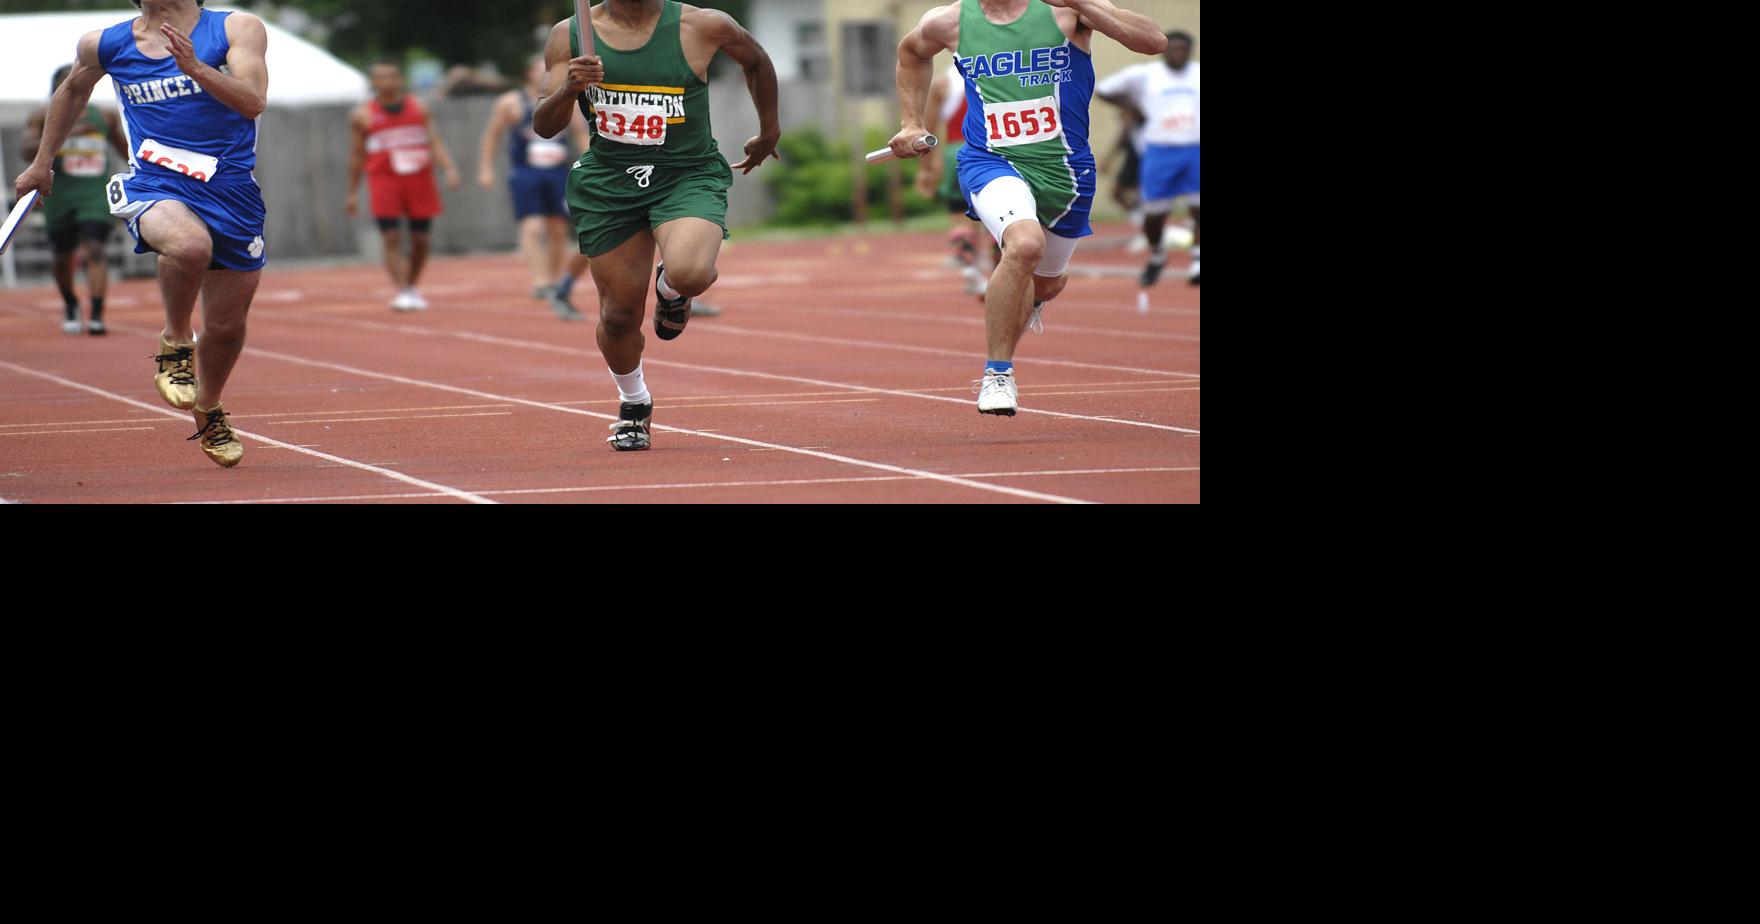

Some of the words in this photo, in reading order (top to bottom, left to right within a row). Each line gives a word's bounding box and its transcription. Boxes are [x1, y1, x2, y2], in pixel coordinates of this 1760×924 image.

[959, 46, 1071, 79] EAGLES
[1019, 69, 1073, 88] TRACK
[597, 110, 664, 139] 1348
[986, 106, 1058, 140] 1653
[109, 180, 123, 205] 8
